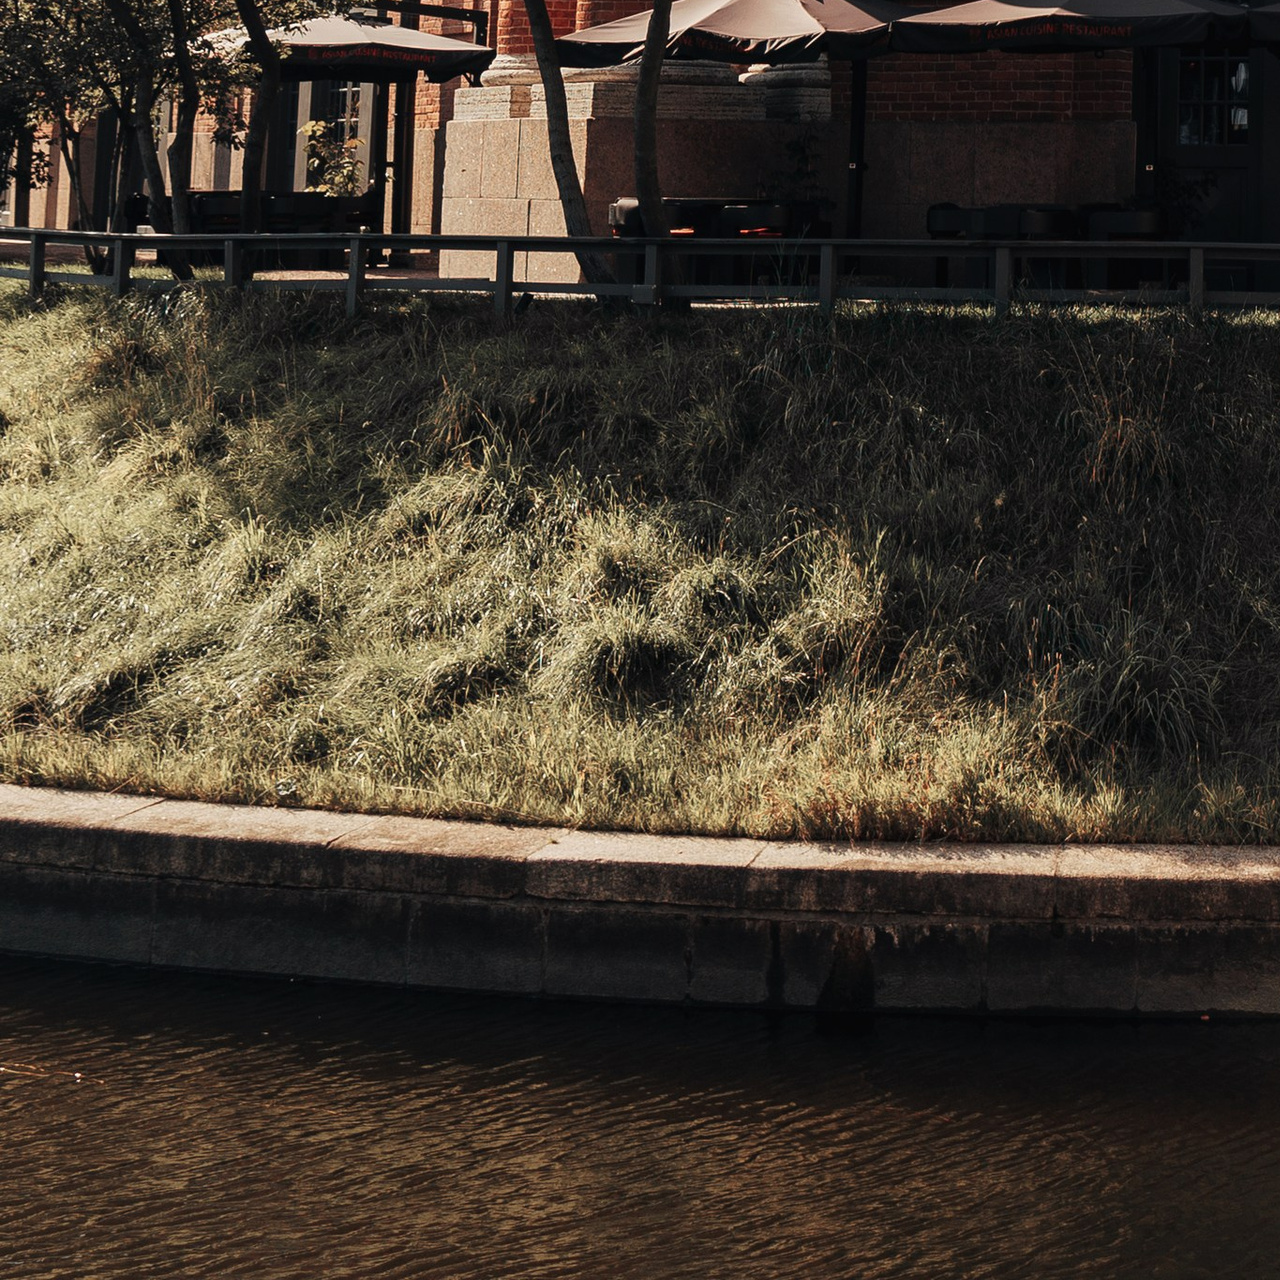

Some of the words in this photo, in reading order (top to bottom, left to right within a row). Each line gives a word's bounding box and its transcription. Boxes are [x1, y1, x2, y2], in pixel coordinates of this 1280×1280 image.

[986, 27, 1017, 40] ASIAN
[1019, 23, 1059, 36] CUISINE
[1062, 23, 1132, 37] RESTAURANT
